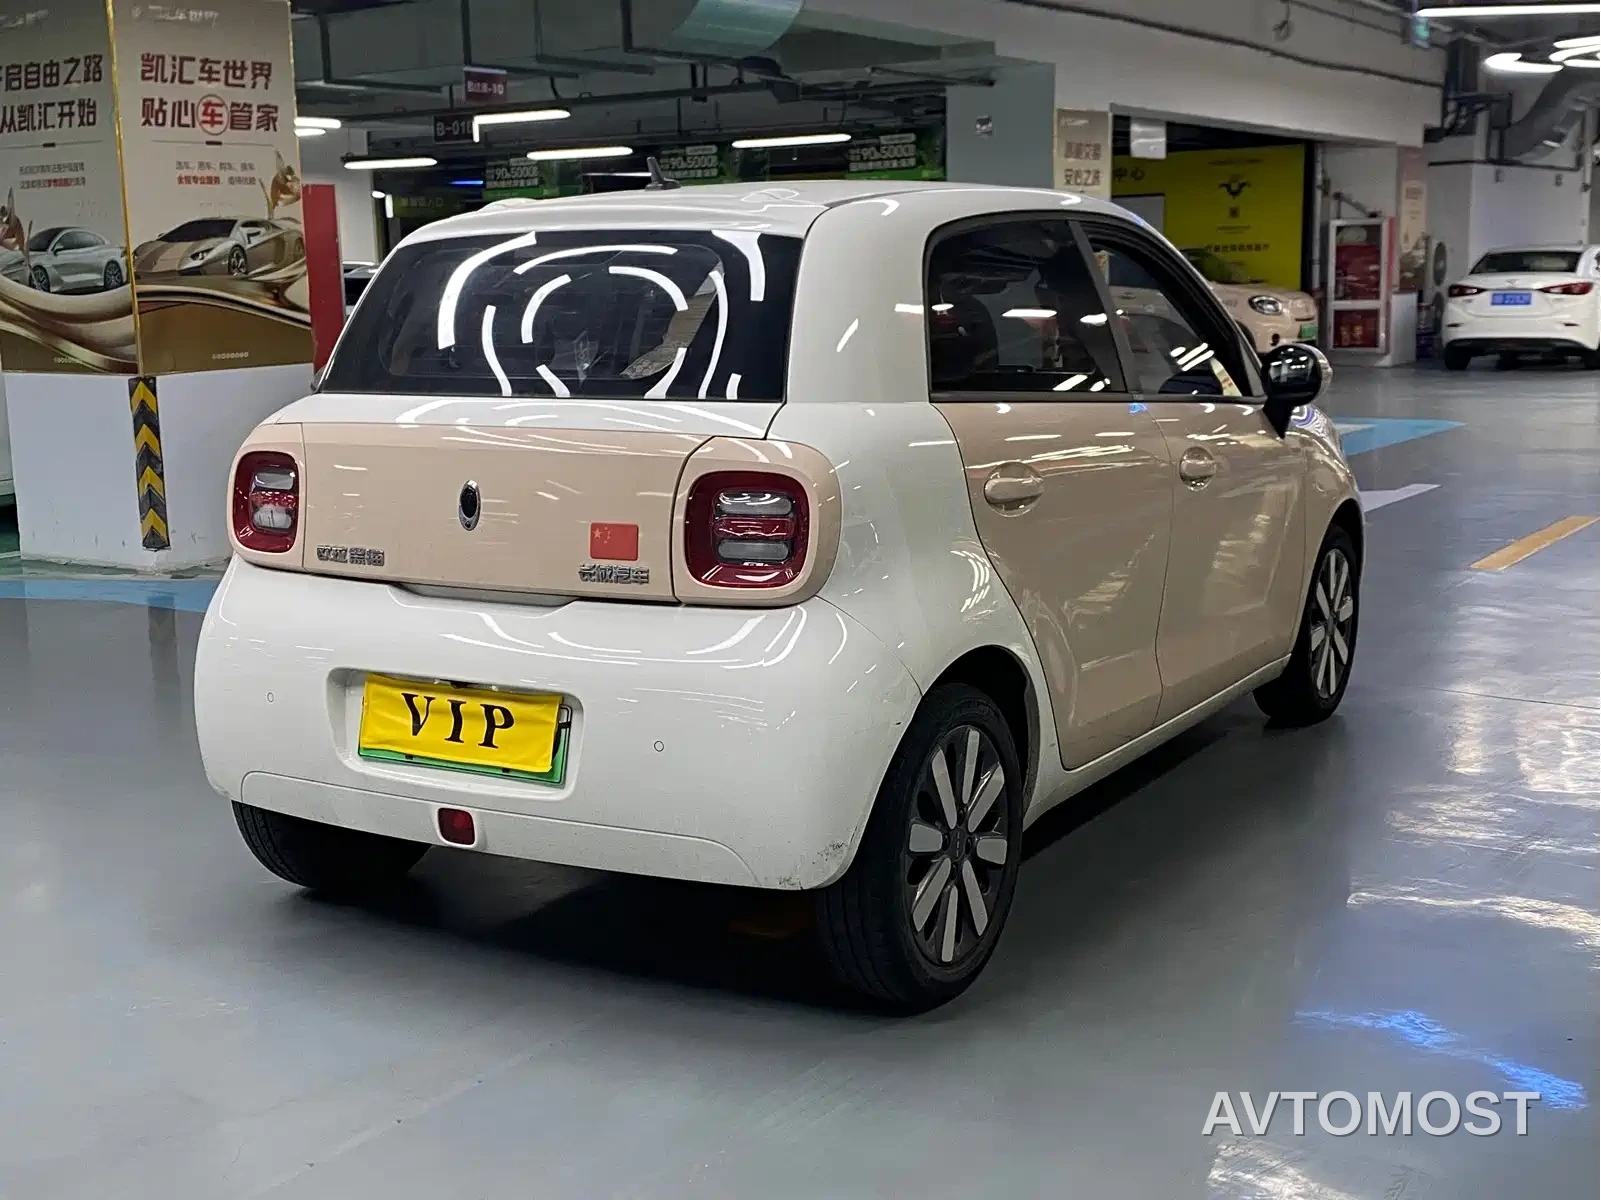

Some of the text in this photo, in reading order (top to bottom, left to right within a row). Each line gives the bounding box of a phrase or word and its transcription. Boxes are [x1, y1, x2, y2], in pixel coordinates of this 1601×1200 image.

[0, 54, 103, 91] 启自由之路
[140, 53, 272, 90] 凯汇车世界
[0, 98, 97, 133] 从凯汇开始
[141, 93, 279, 135] 贴心车管家
[578, 564, 650, 585] 长城汽车
[401, 692, 515, 749] VIP
